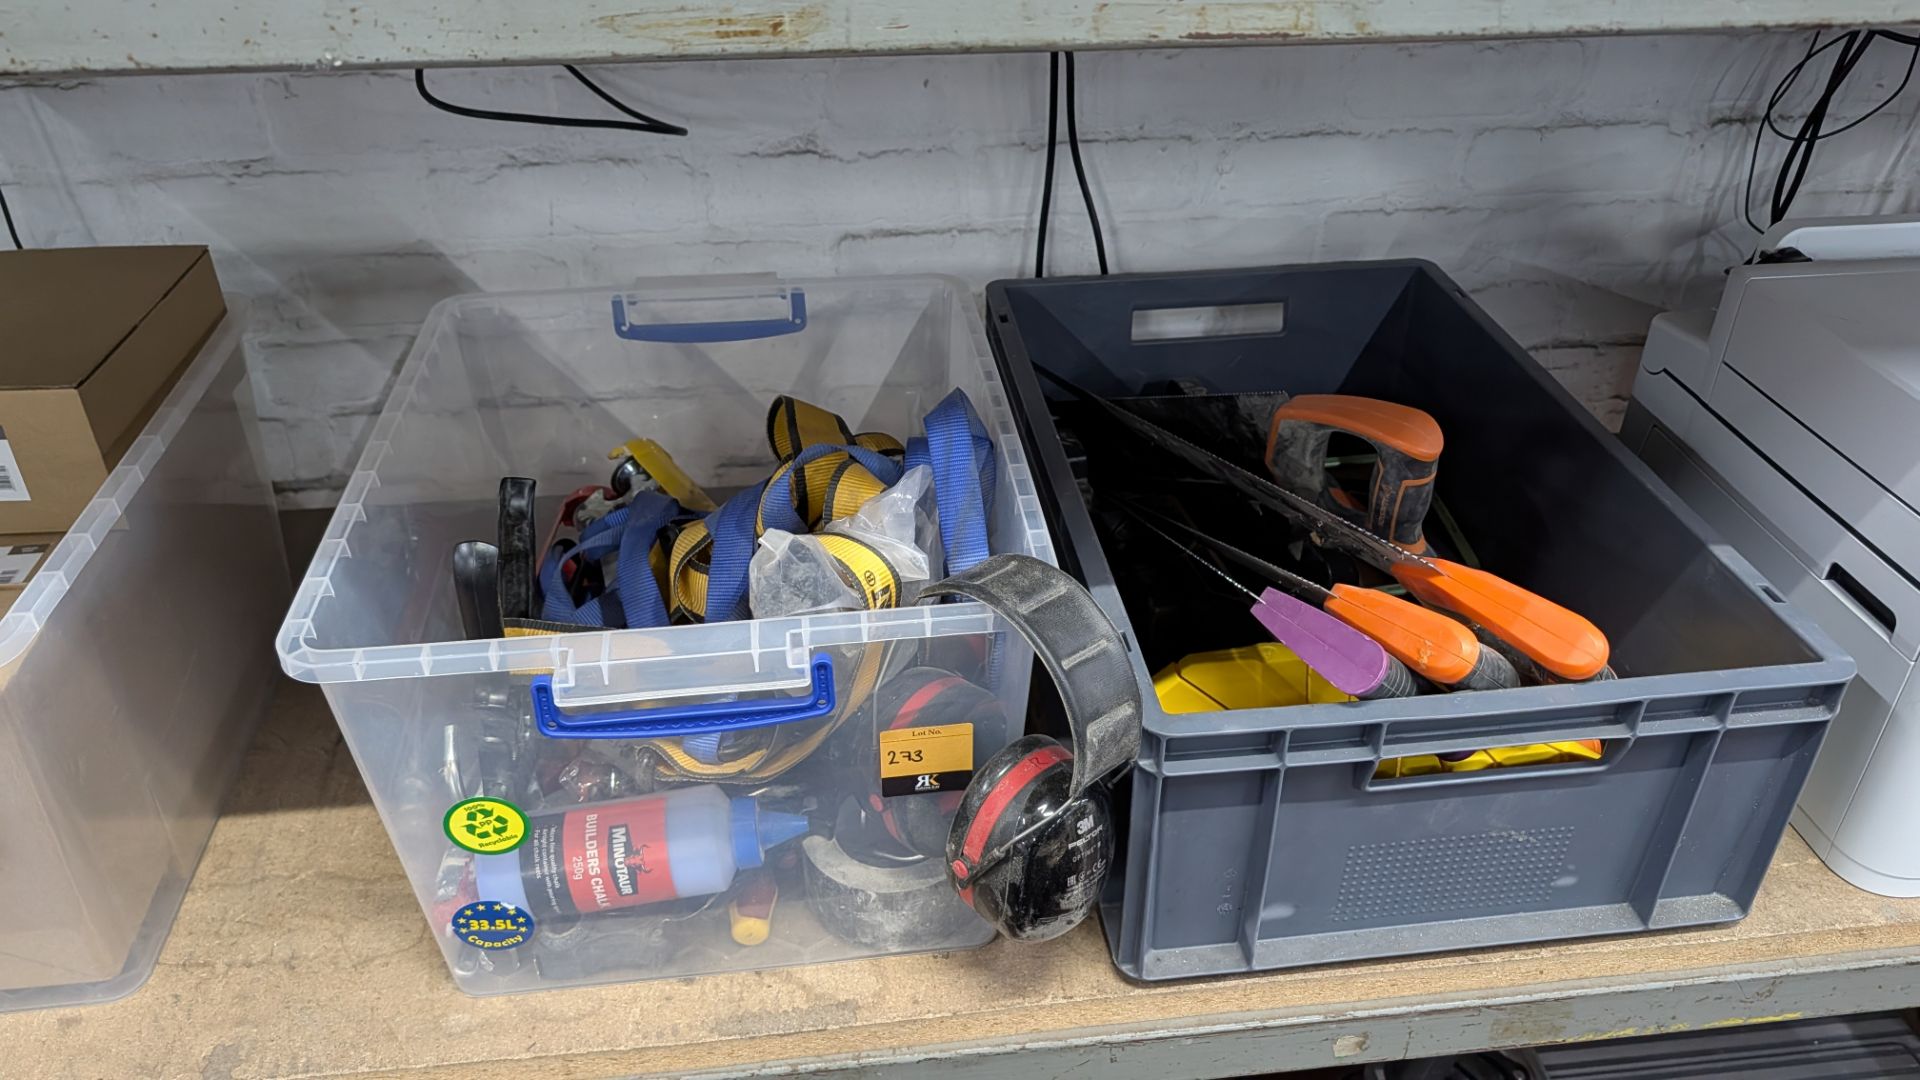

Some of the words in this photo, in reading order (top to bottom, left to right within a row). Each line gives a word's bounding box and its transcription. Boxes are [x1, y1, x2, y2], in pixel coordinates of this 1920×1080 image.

[887, 750, 924, 765] 273
[1076, 814, 1095, 836] 3M
[478, 834, 518, 848] Recyclable
[585, 813, 601, 877] BUILDERS
[1068, 824, 1103, 850] PELTOR
[572, 855, 584, 881] 250g
[611, 826, 634, 896] MINOTAUR
[467, 919, 517, 931] 33.5L
[468, 934, 523, 948] Capacity
